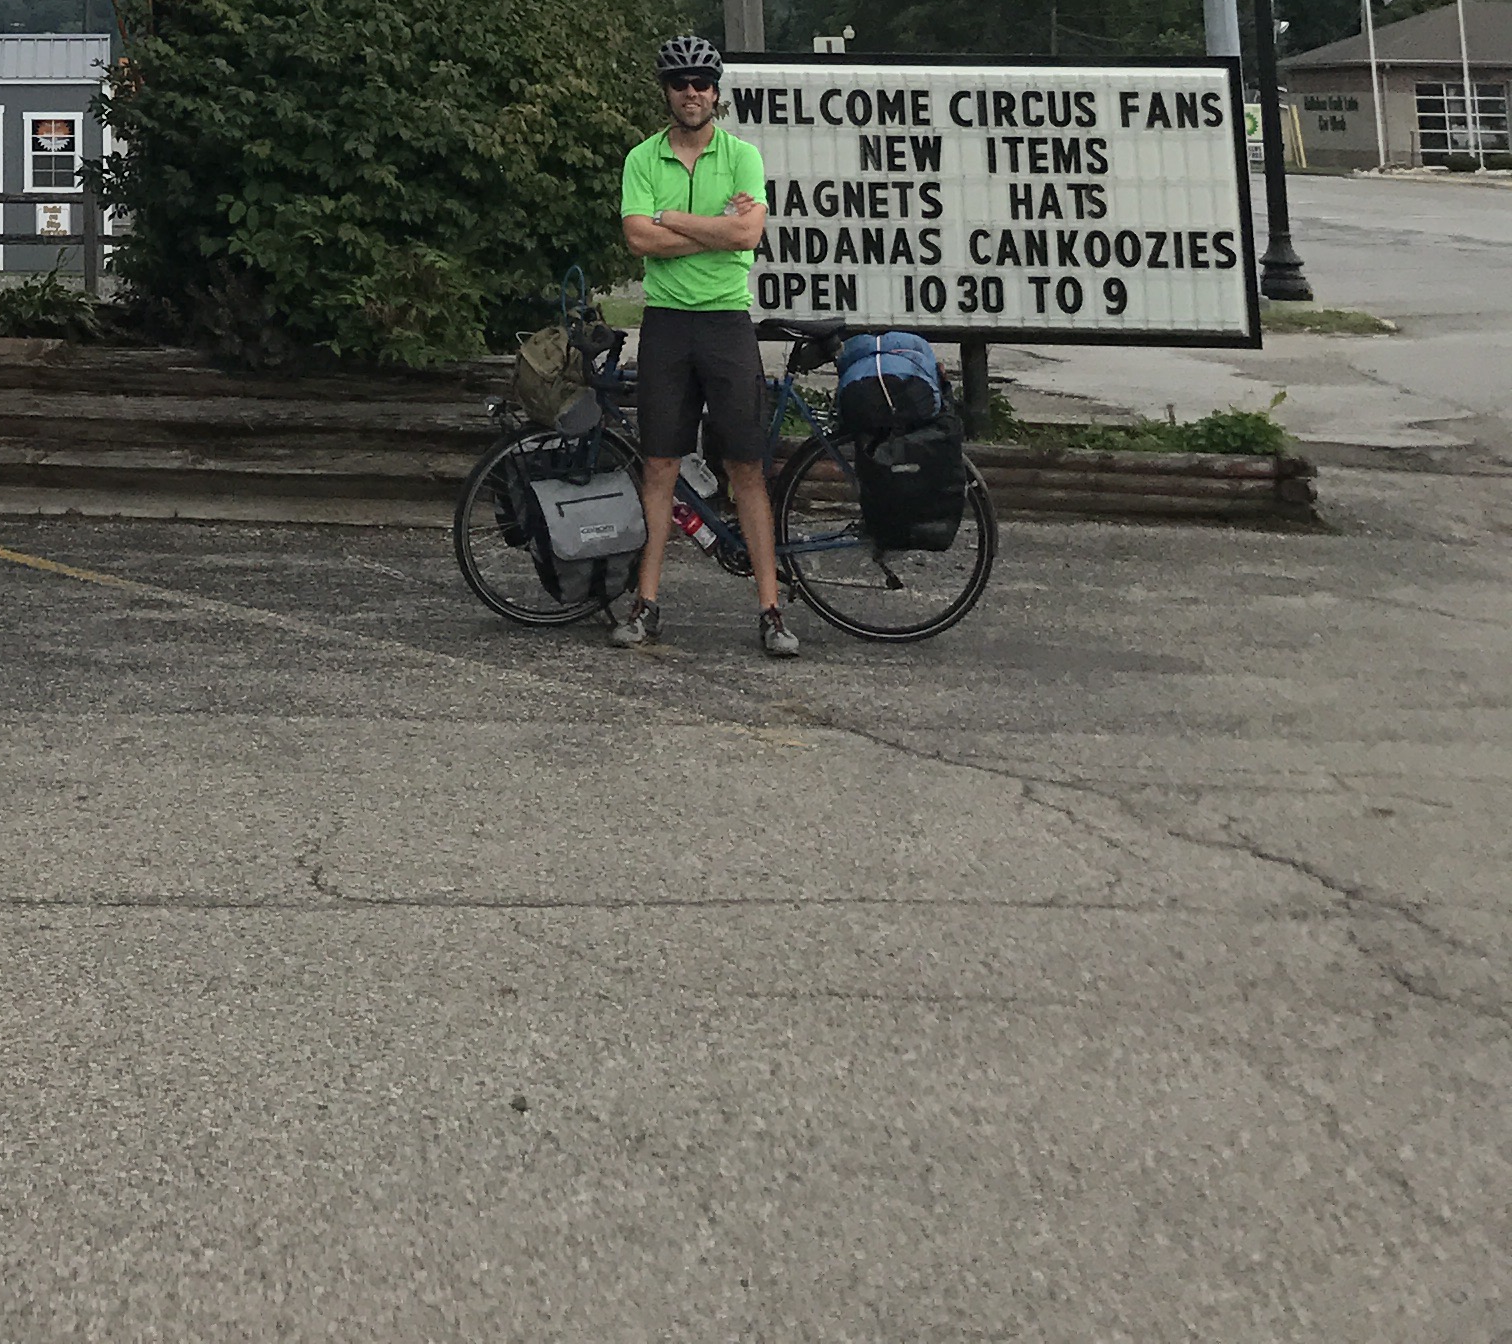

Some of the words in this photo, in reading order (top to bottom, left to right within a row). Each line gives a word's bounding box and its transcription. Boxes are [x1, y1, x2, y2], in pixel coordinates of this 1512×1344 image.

[732, 87, 931, 126] WELCOME
[949, 90, 1097, 128] CIRCUS
[1120, 91, 1224, 129] FANS
[859, 134, 942, 172] NEW
[987, 137, 1109, 175] ITEMS
[1009, 182, 1107, 220] HATS
[754, 226, 942, 266] ANDANAS
[758, 272, 858, 312] OPEN
[1028, 276, 1084, 315] TO
[1102, 277, 1128, 316] 9
